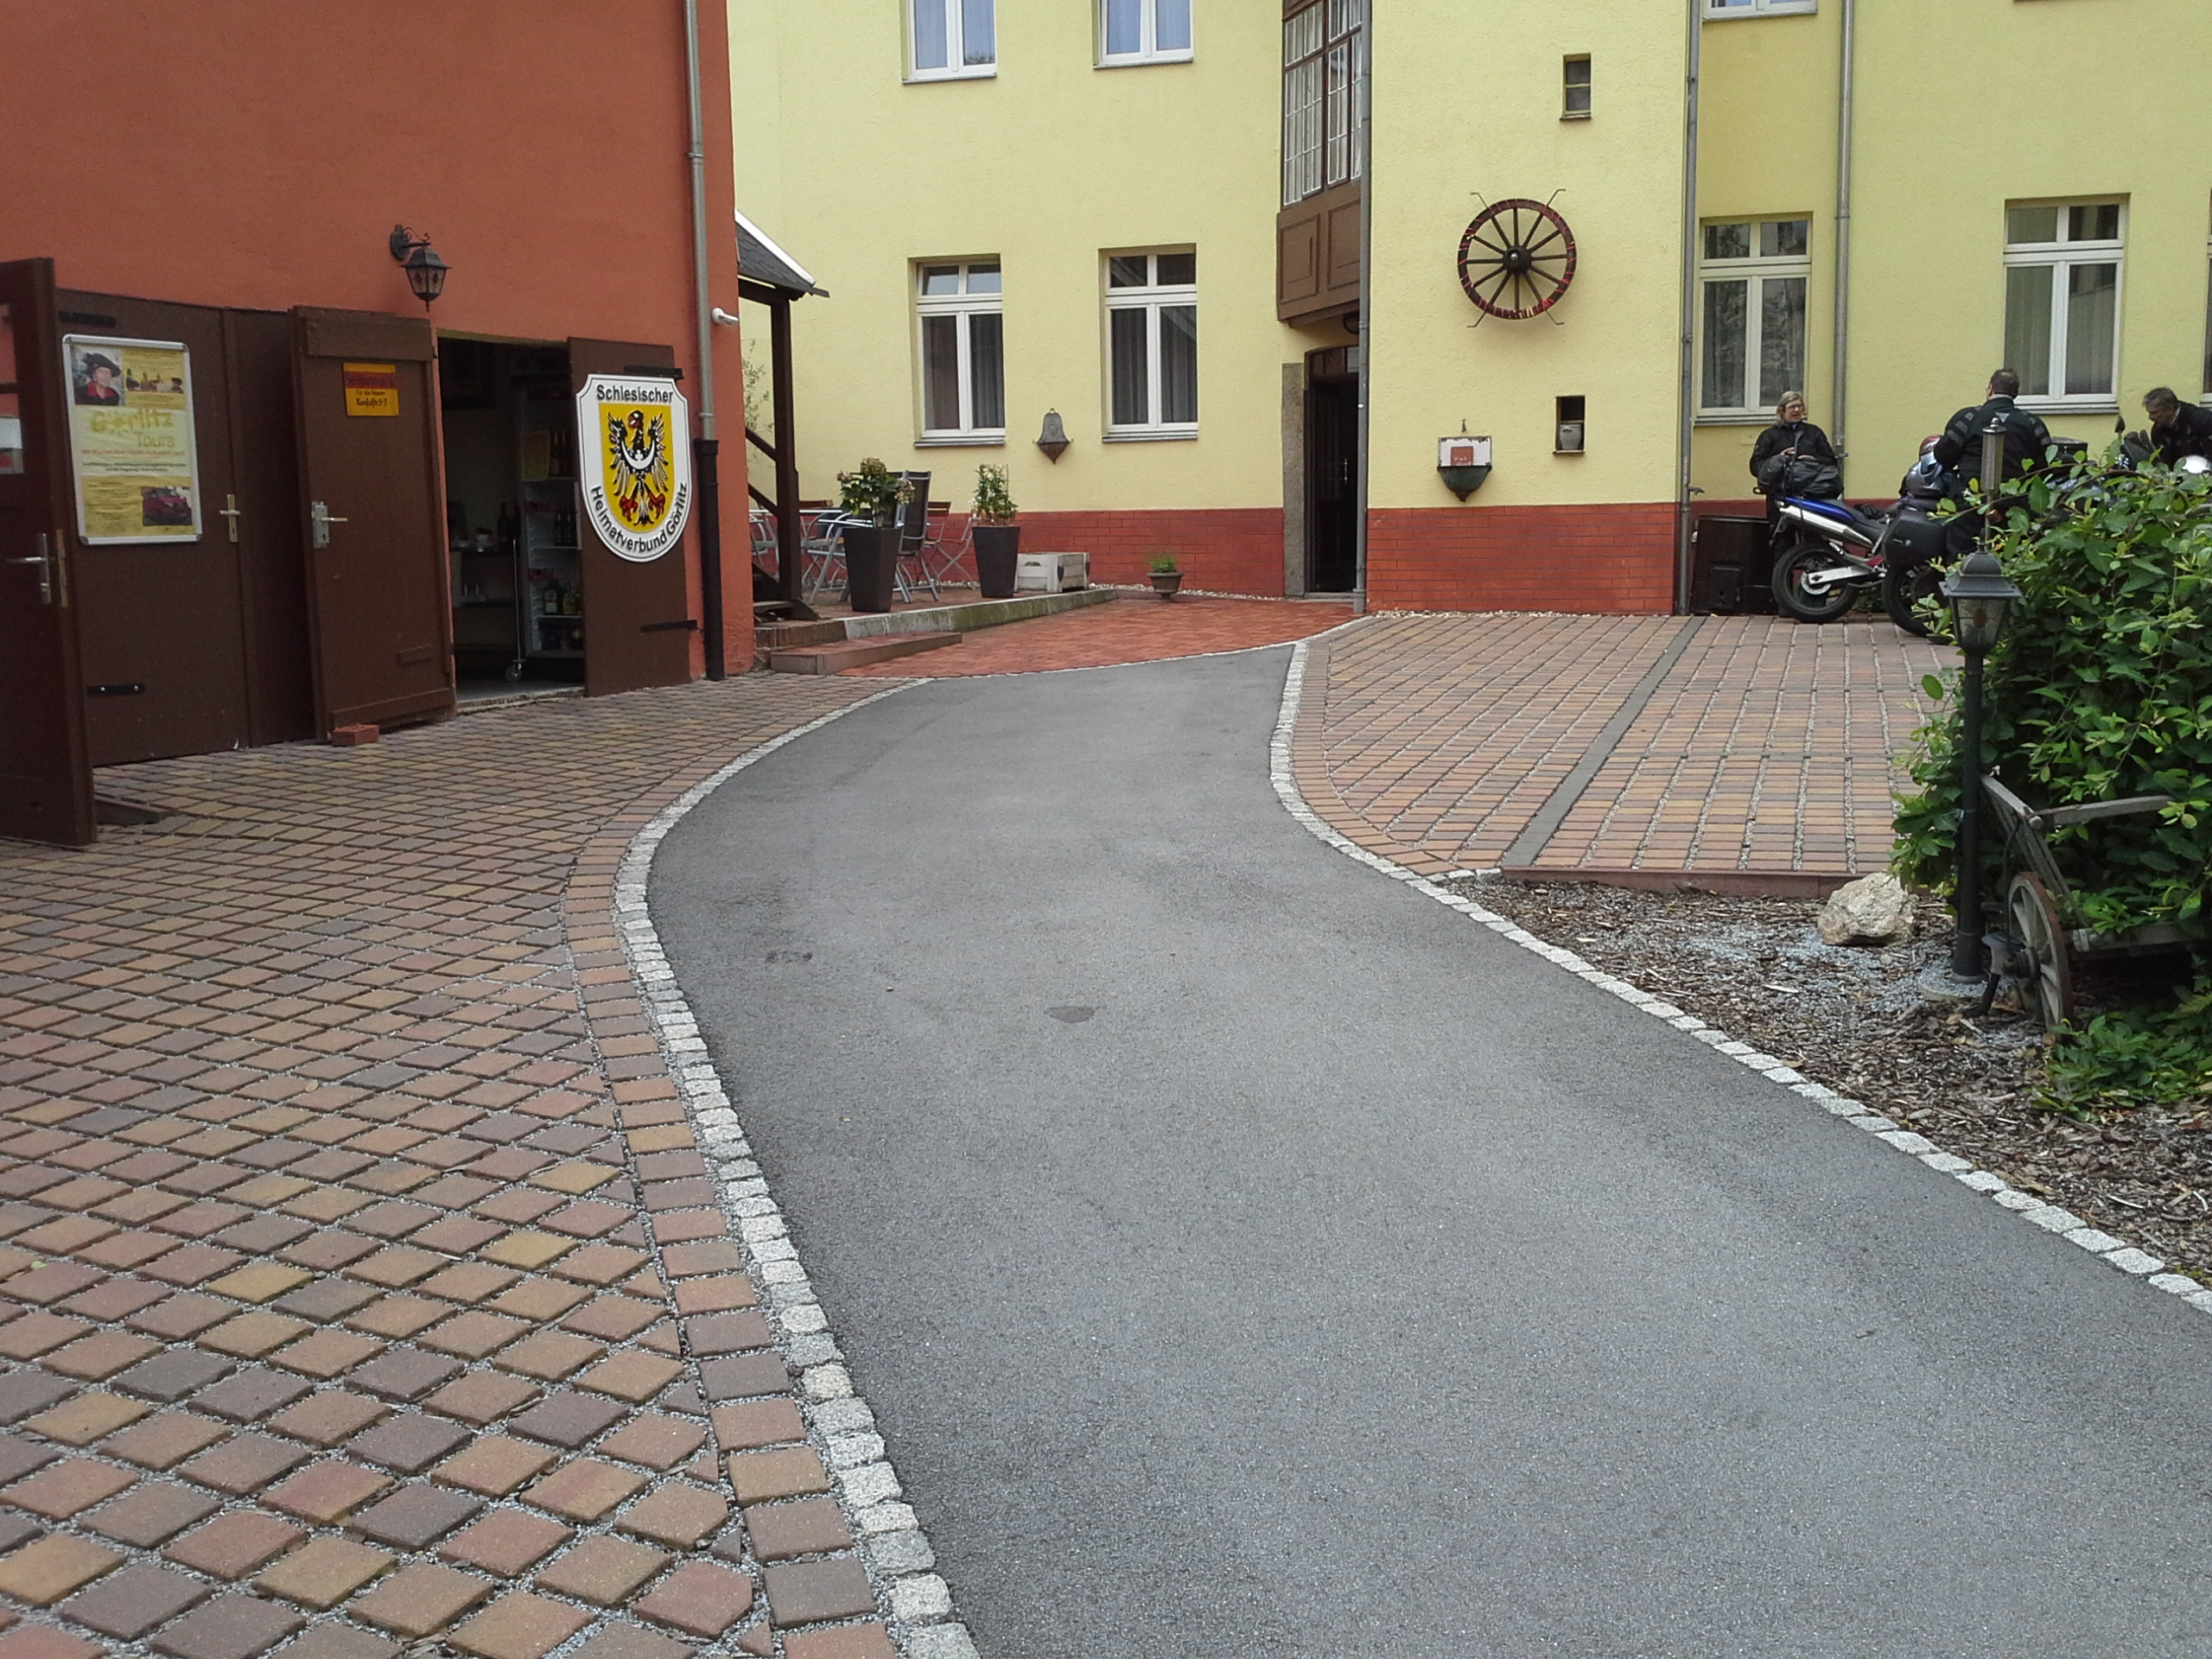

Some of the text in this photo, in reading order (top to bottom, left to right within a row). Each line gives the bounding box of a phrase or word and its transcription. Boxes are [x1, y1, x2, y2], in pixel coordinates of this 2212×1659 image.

[596, 384, 674, 404] Schlesischer
[591, 482, 688, 554] Heimatverbund Görlitz
